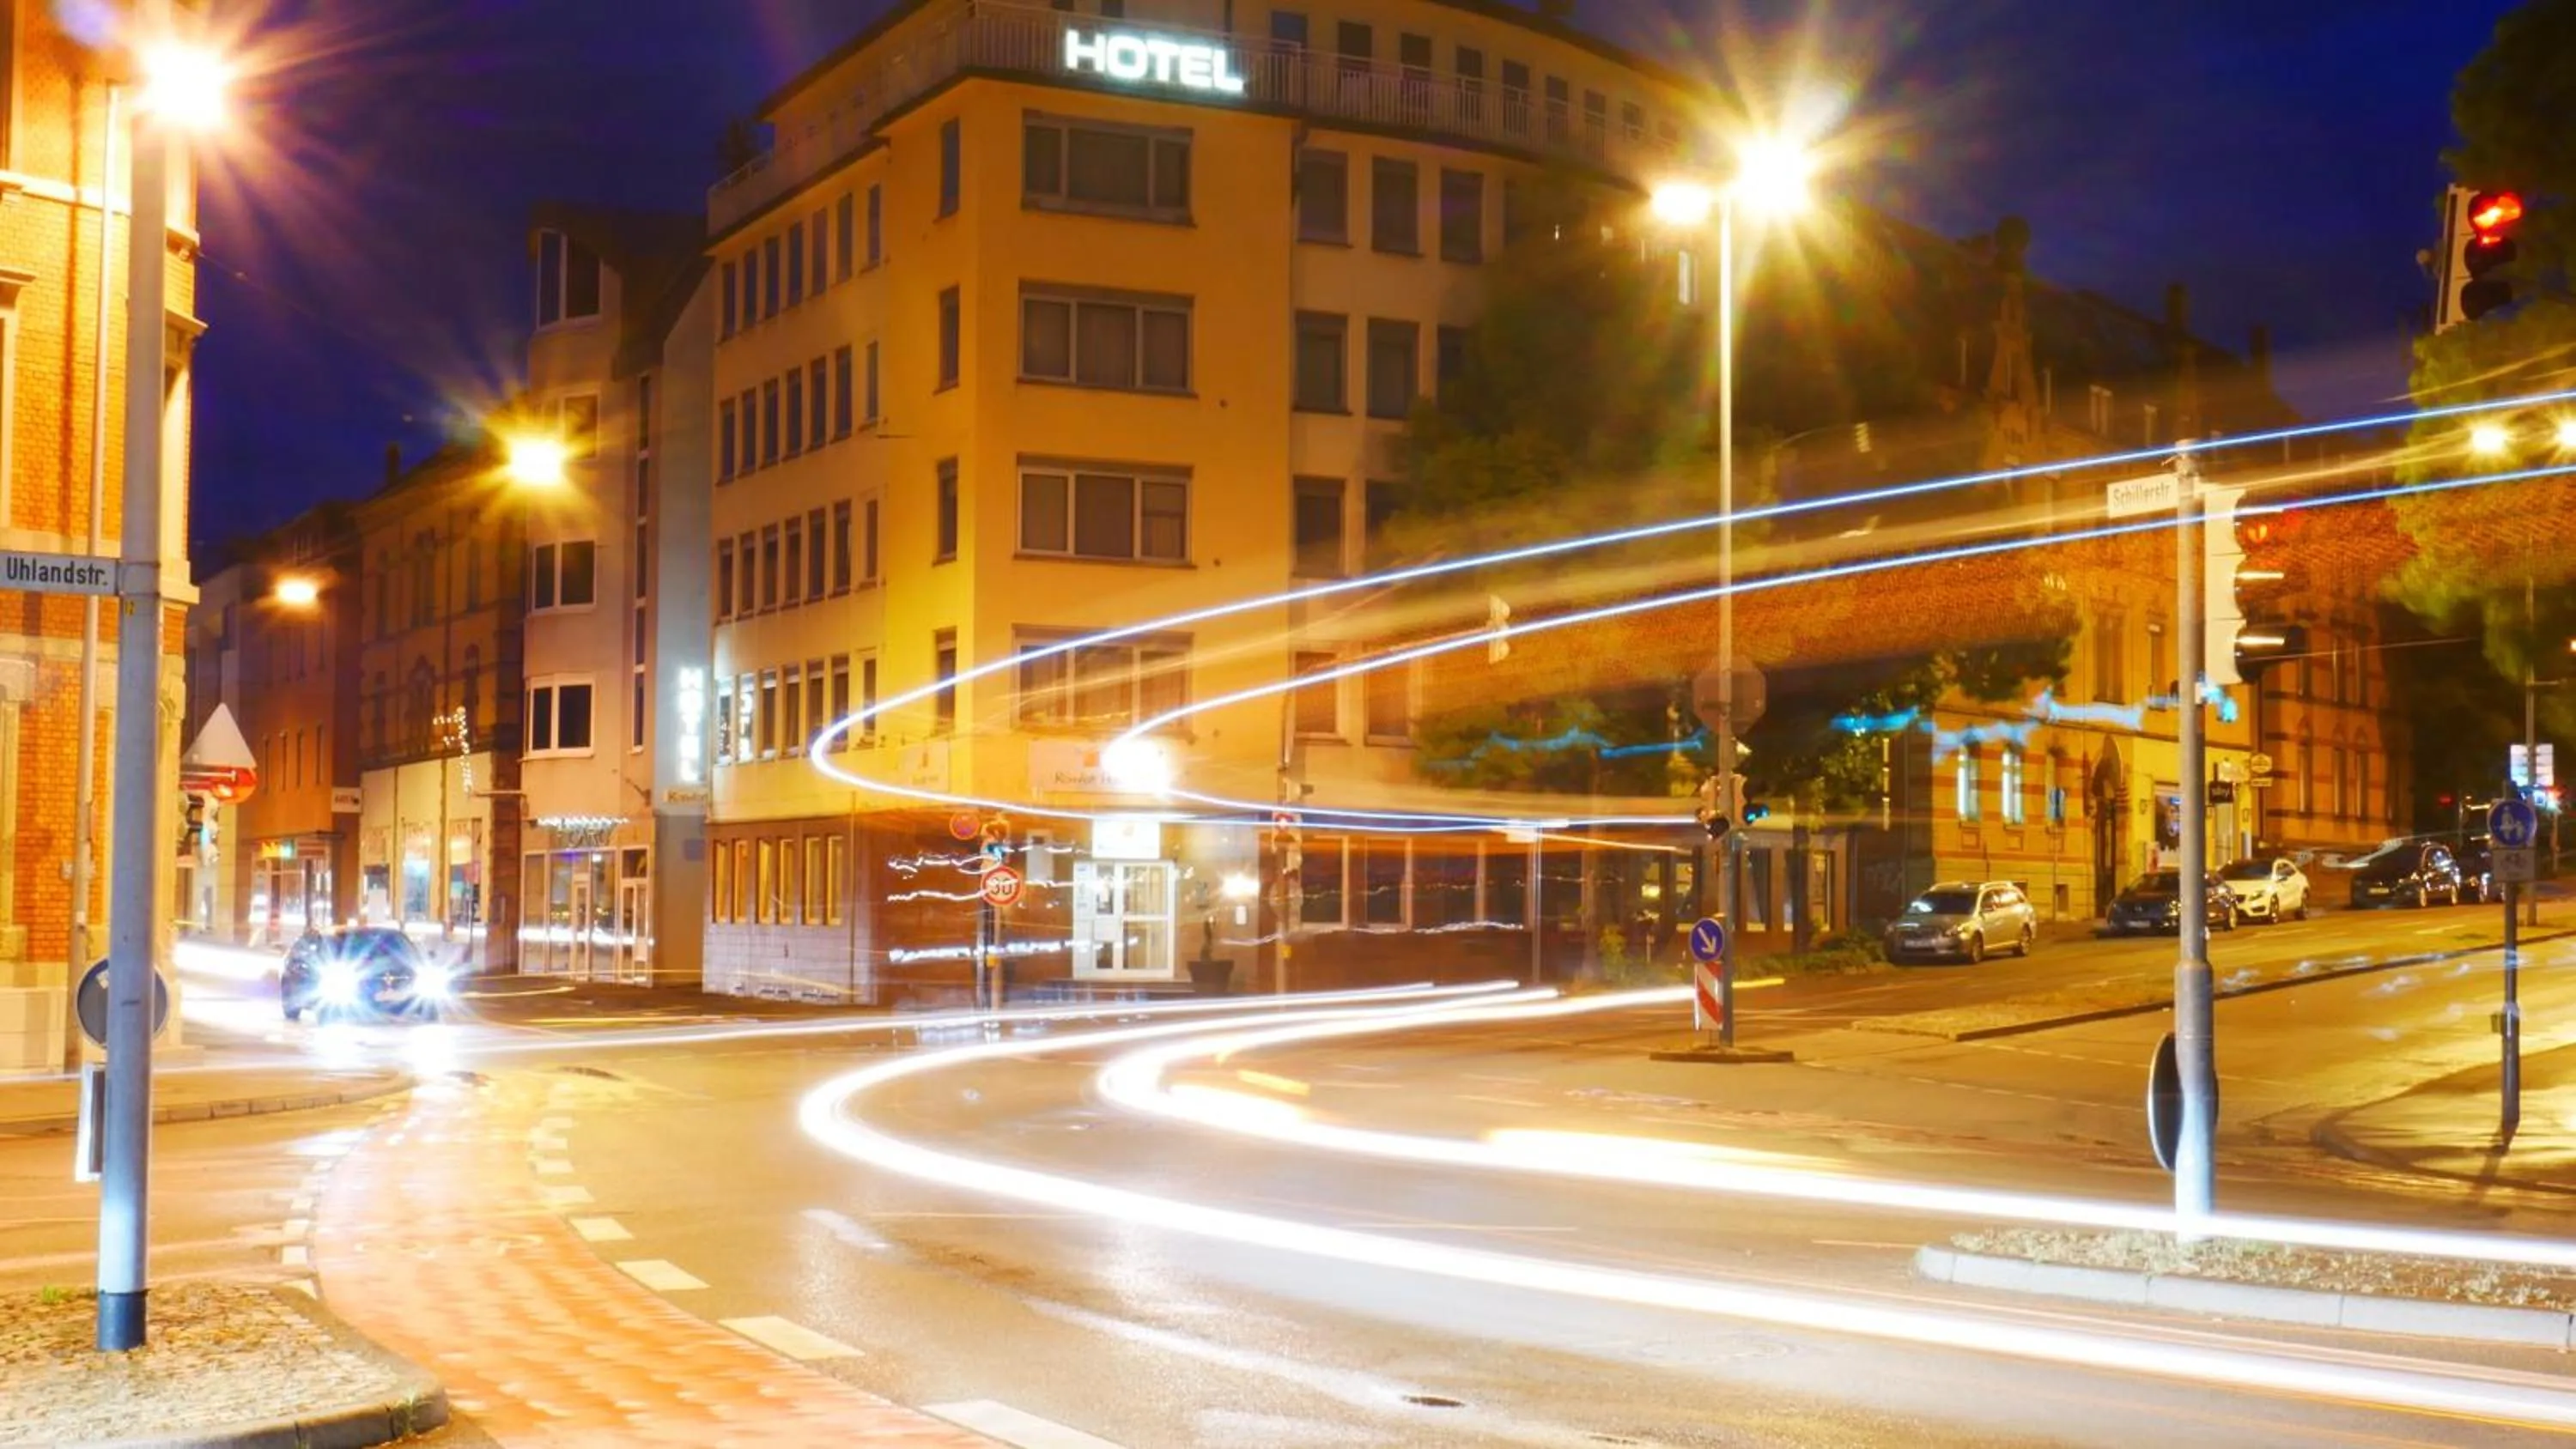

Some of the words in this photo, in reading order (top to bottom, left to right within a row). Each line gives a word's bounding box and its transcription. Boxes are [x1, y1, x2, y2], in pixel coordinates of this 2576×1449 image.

[1066, 28, 1244, 91] HOTEL
[7, 555, 108, 585] Uhlandstr.
[679, 667, 704, 782] HOTEL
